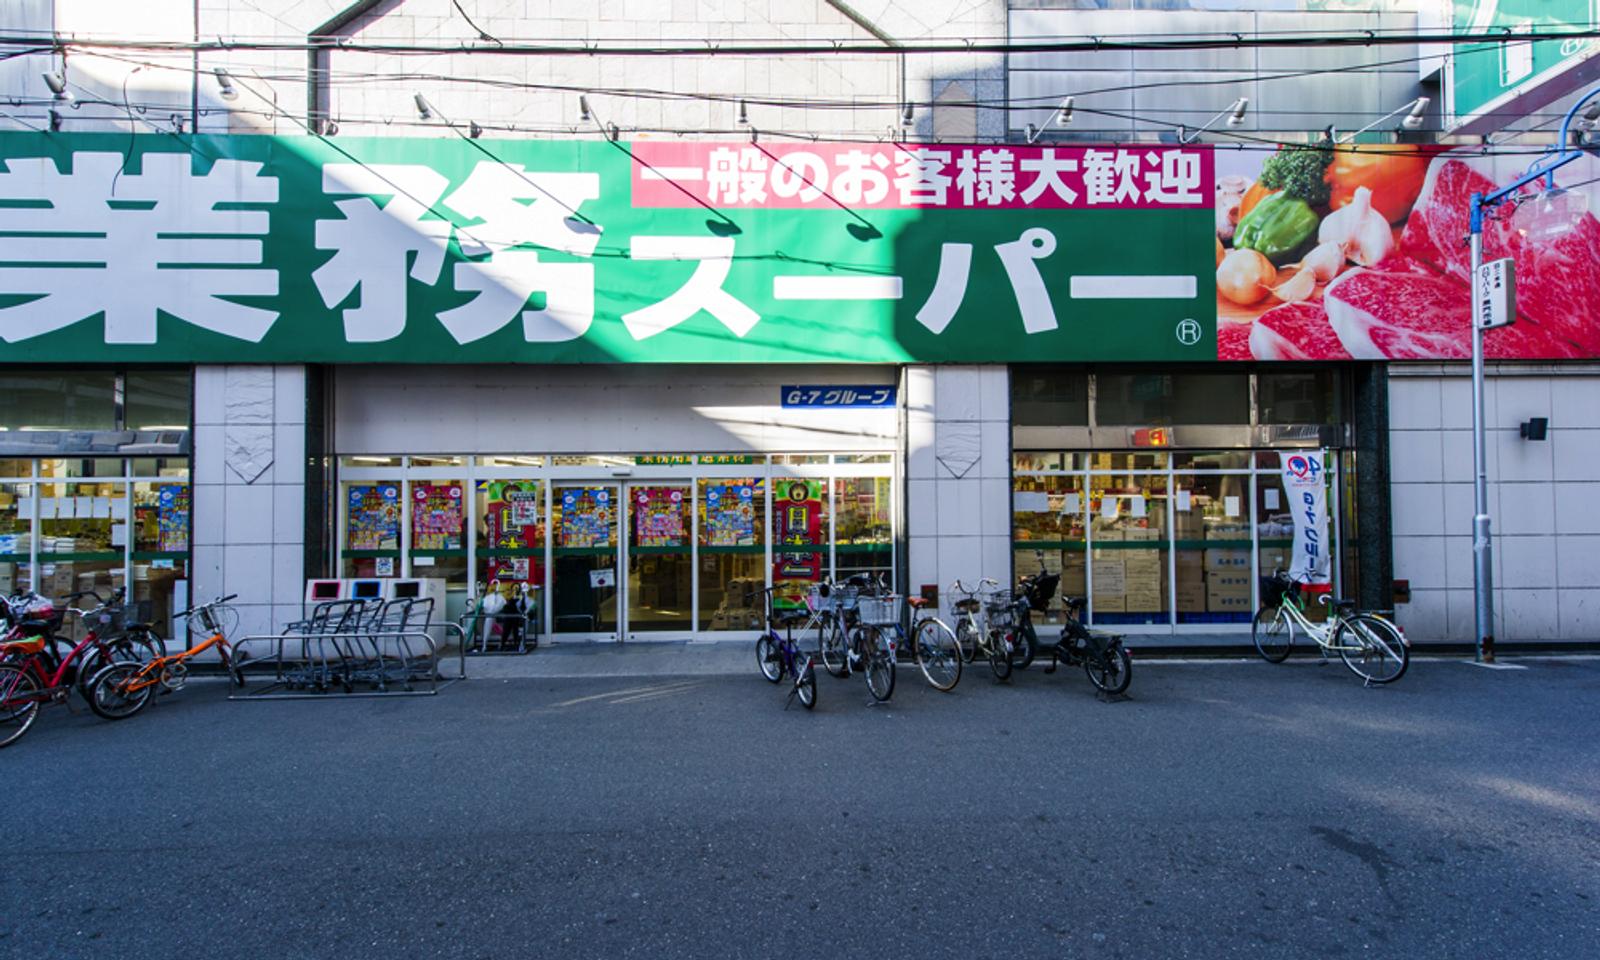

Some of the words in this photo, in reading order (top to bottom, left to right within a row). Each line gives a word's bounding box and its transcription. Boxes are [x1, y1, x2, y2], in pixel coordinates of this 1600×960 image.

[640, 147, 1203, 206] 一般のお客様大歓迎
[0, 151, 1198, 346] 業務スーパー
[823, 390, 890, 405] グループ
